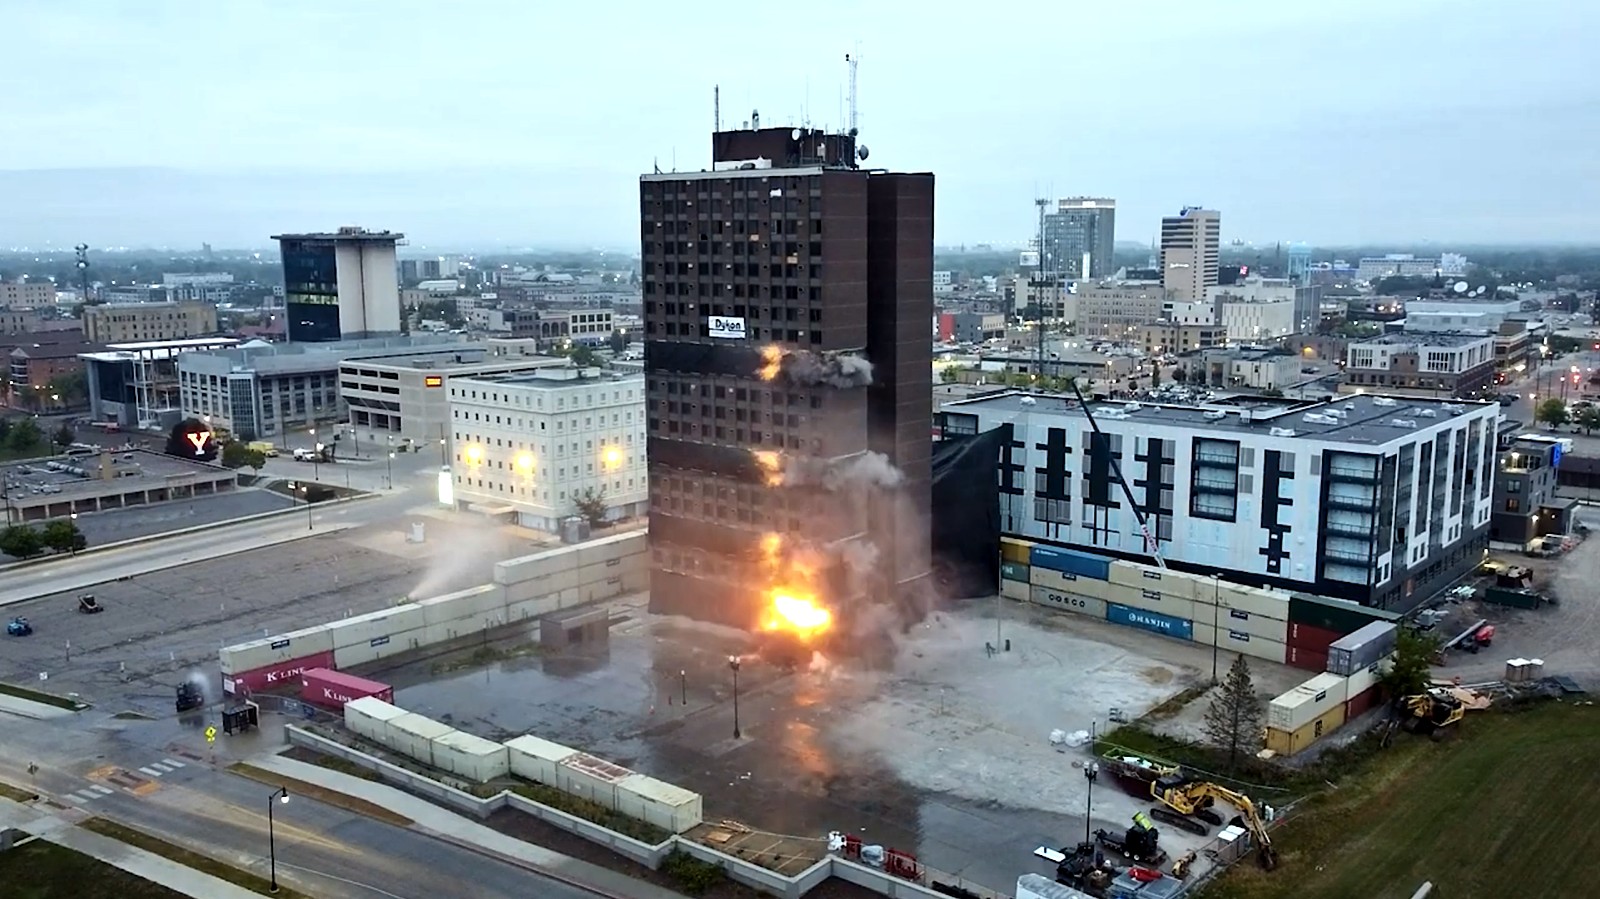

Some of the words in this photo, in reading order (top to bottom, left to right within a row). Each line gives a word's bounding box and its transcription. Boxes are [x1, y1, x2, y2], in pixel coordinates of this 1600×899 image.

[187, 431, 210, 455] Y
[1048, 594, 1085, 608] COSCO
[1136, 615, 1170, 629] HANJIN
[267, 671, 278, 682] K
[323, 687, 333, 699] K
[333, 692, 352, 703] LIN
